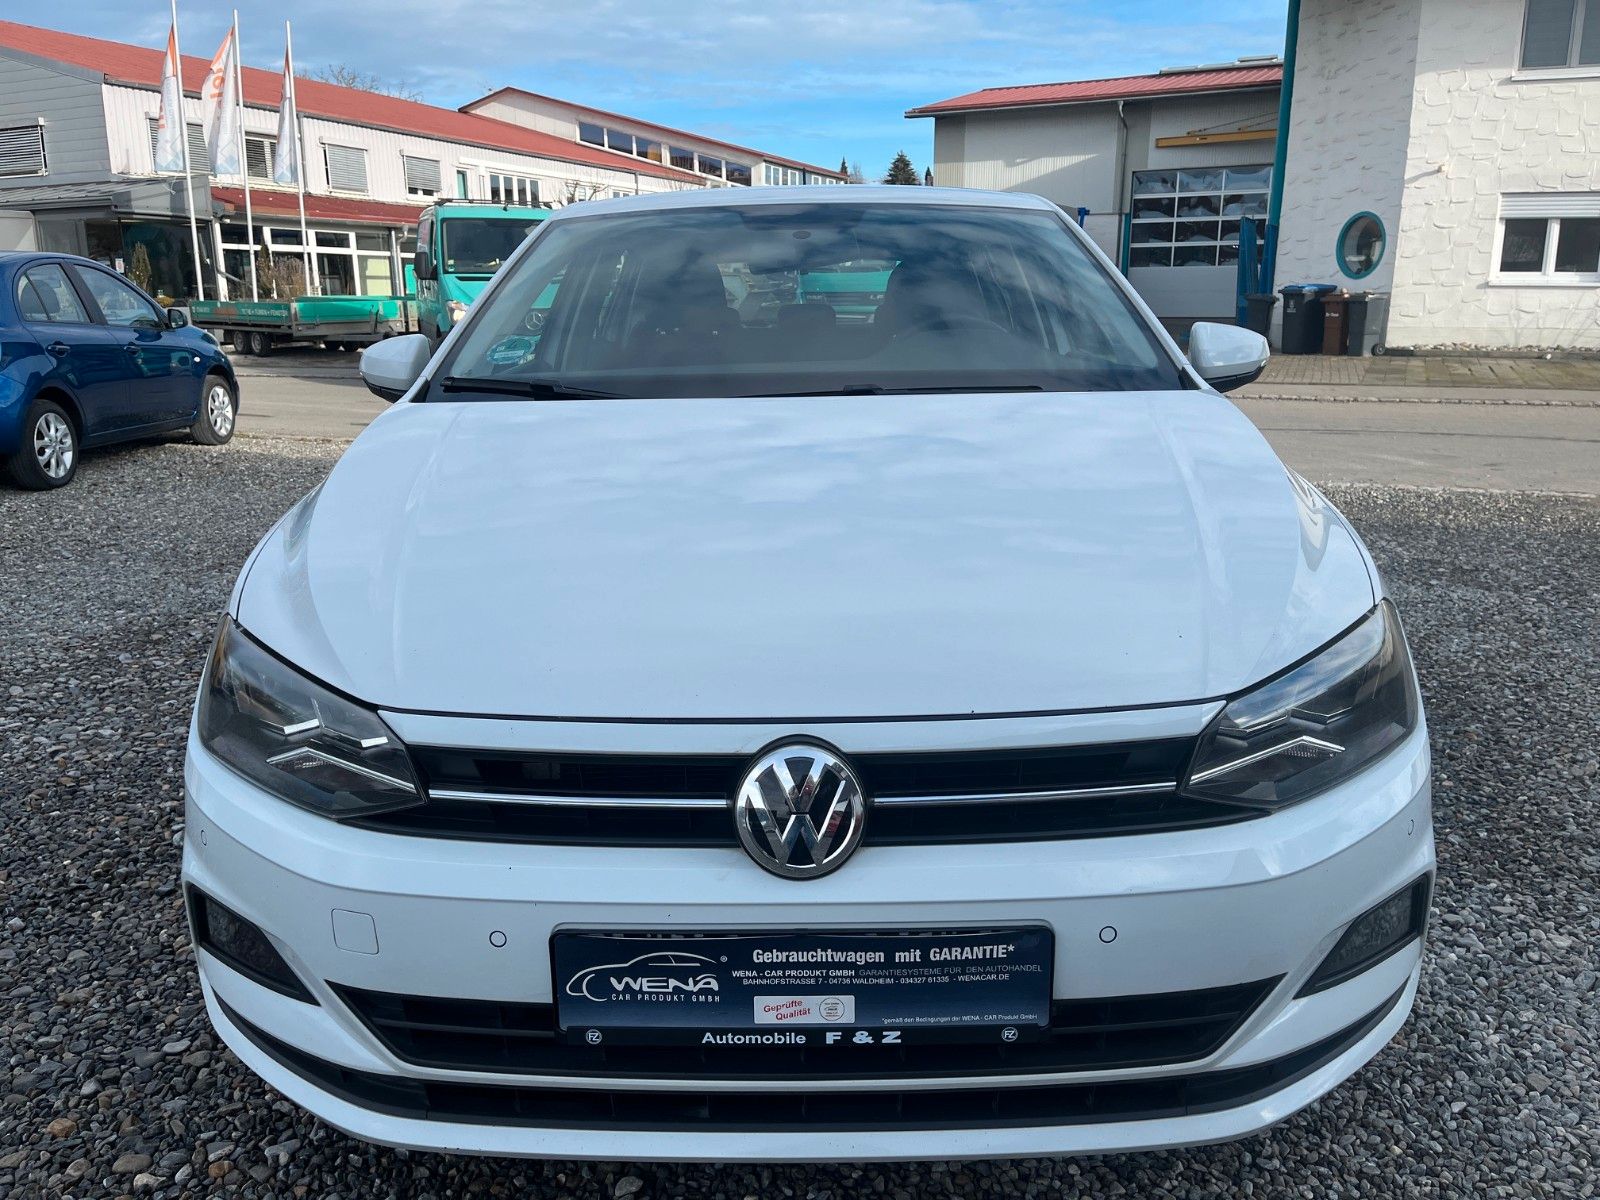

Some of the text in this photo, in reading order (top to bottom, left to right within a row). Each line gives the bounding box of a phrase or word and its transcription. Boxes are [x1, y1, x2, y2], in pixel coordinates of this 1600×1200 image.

[736, 746, 864, 877] VW
[752, 948, 885, 965] Gebrauchtwagen
[895, 949, 922, 963] mit
[785, 969, 827, 977] PRODUKT
[828, 969, 855, 977] GMBH
[858, 967, 942, 976] GARANTIESYSTEME
[985, 964, 1043, 973] AUTOHANDEL
[609, 974, 719, 993] WENA
[852, 977, 894, 985] WALDHEIM
[900, 976, 926, 984] 034327
[611, 993, 720, 1003] CAR PRODUKT GMBH
[763, 999, 803, 1013] Geprüfte
[775, 1007, 811, 1021] Qualität
[587, 1031, 601, 1042] FZ
[702, 1030, 902, 1044] Automobile F & Z
[1004, 1029, 1017, 1041] FZ
